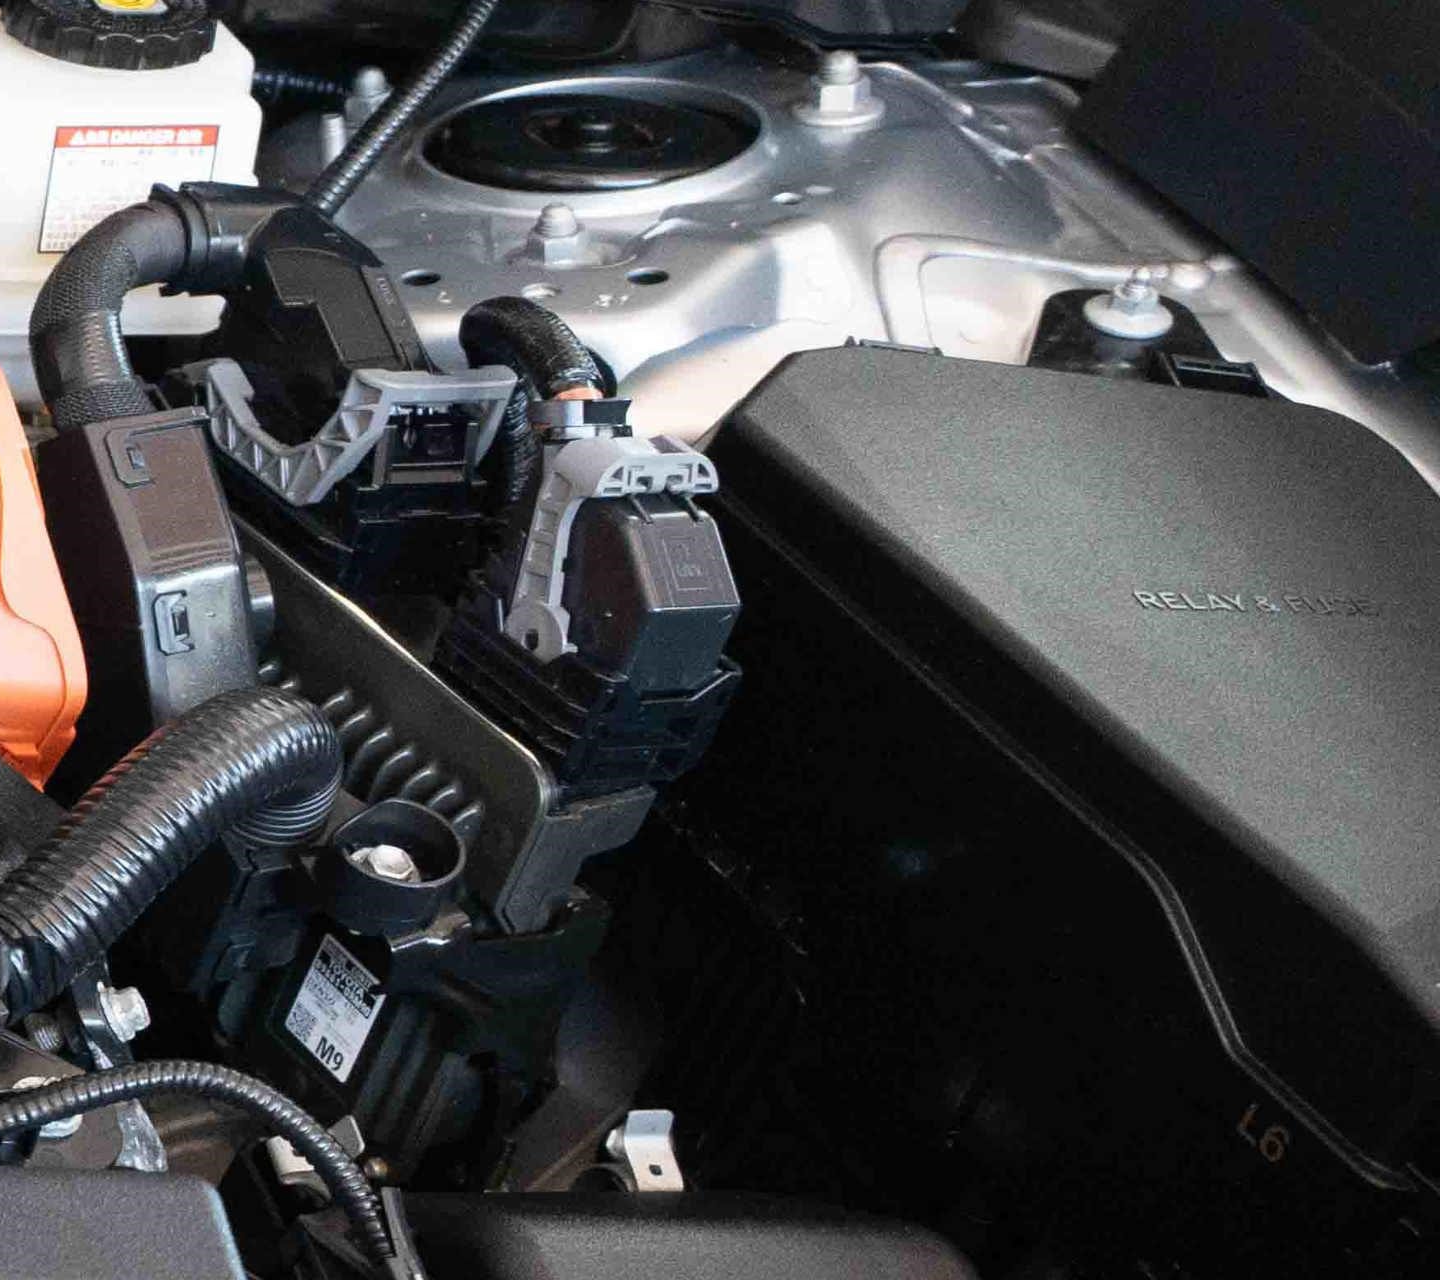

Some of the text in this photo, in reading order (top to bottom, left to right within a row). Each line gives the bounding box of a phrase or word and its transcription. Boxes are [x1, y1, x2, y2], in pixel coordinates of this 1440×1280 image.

[1132, 589, 1379, 618] RELAY & FUSE
[328, 958, 366, 1002] TOYOTA
[315, 1035, 345, 1071] M9
[1236, 1102, 1290, 1163] L6
